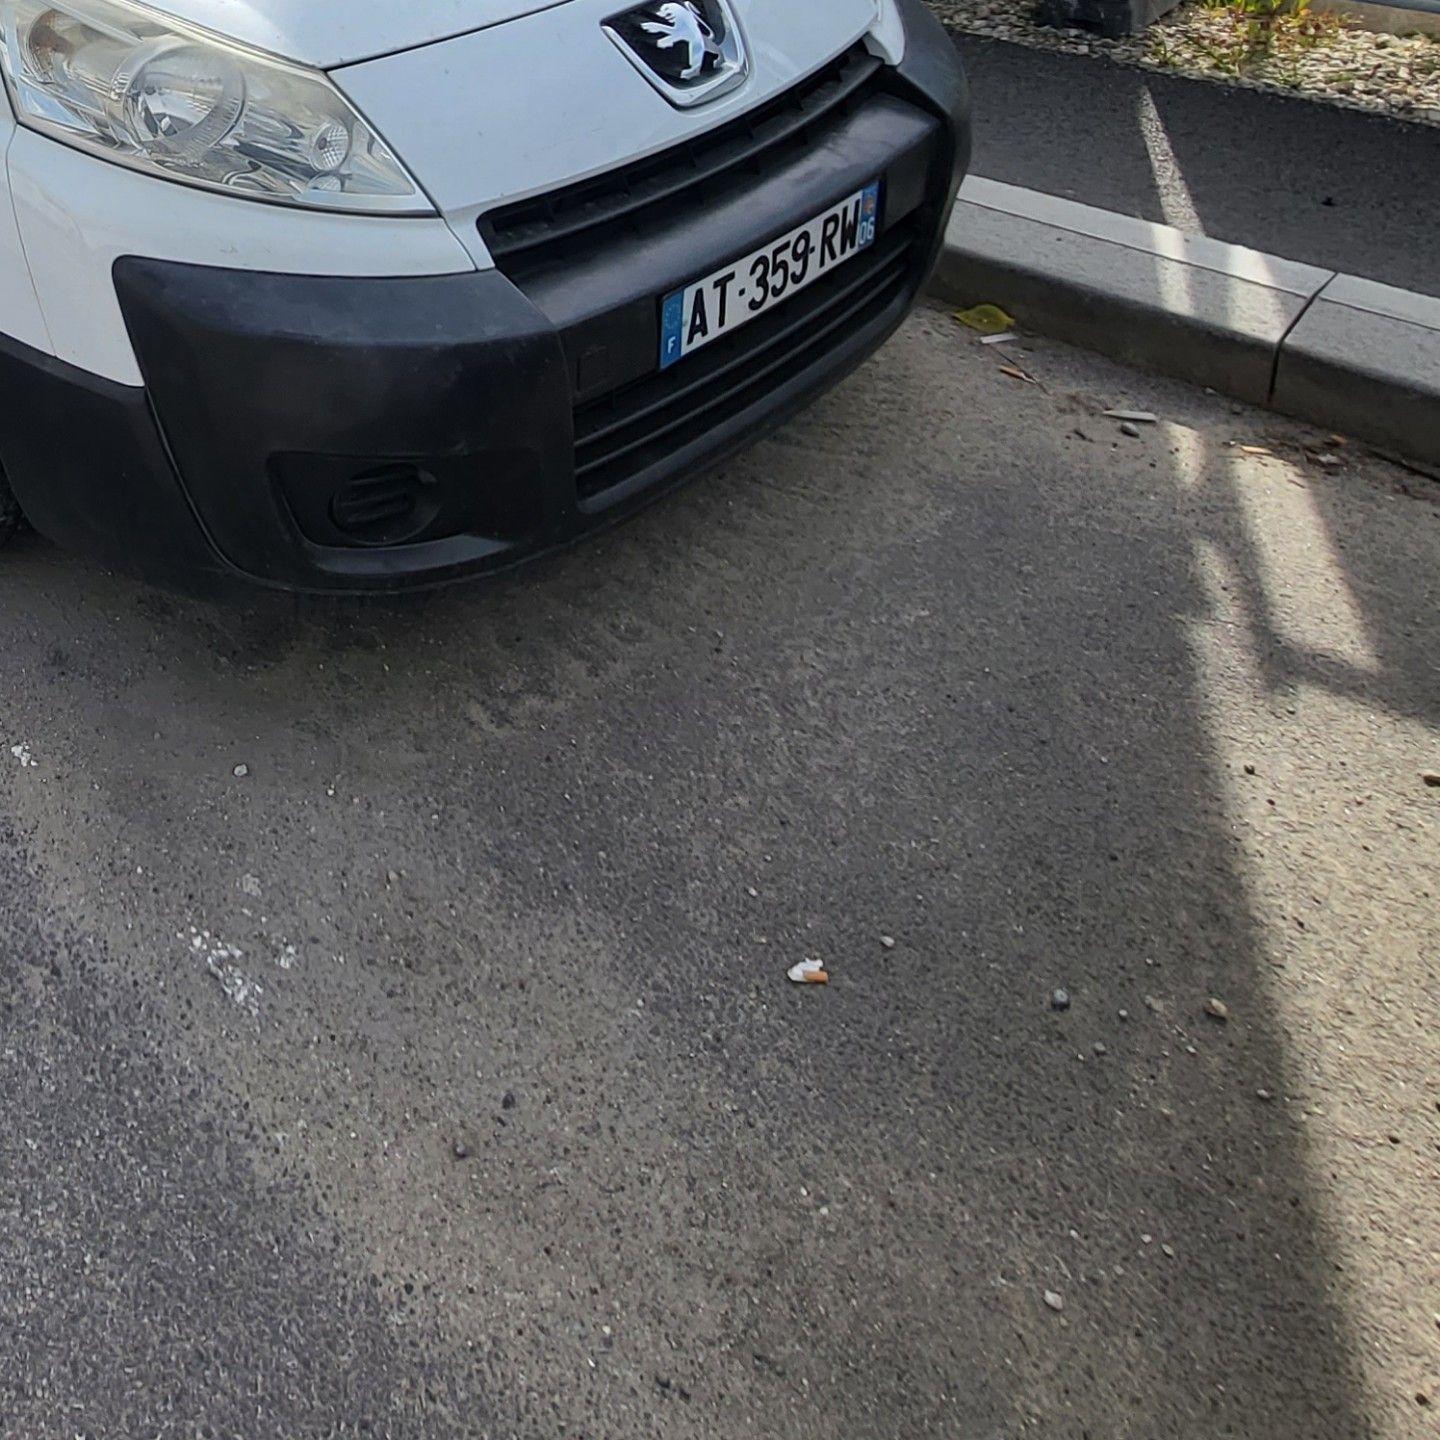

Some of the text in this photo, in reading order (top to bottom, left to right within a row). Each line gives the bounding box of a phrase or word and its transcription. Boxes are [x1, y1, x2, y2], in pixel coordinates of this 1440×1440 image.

[667, 198, 875, 354] F AT-359-RW 06
